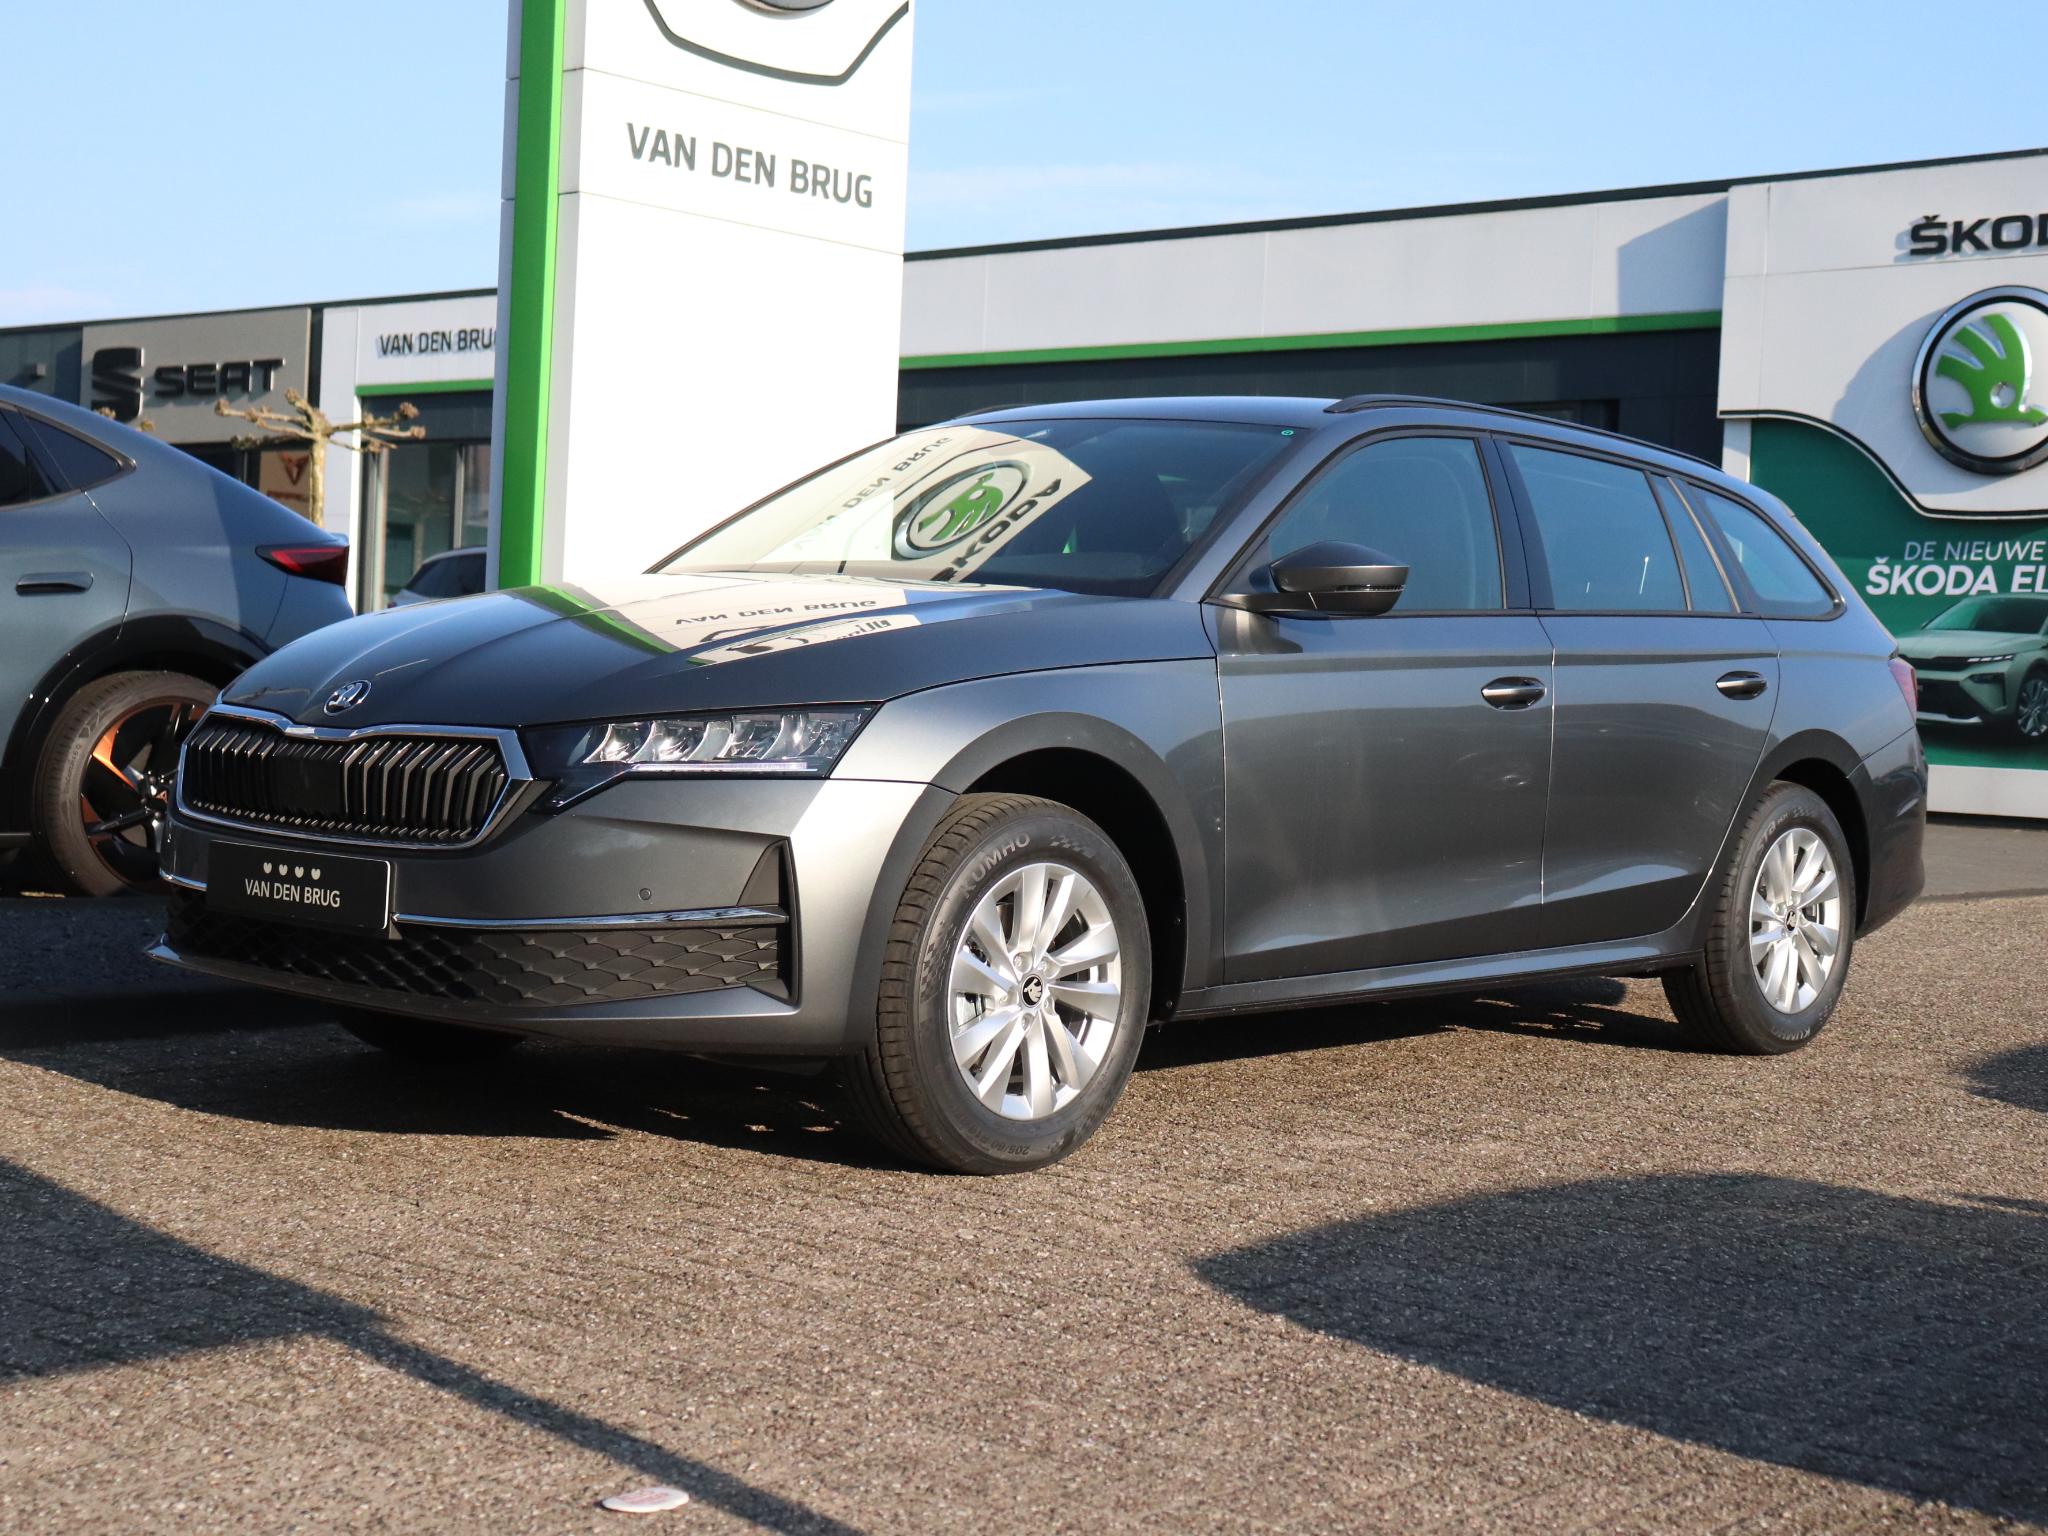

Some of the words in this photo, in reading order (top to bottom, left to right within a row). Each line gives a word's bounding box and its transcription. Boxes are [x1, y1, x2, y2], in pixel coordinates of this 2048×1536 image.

[627, 122, 696, 171] VAN
[712, 141, 776, 188] DEN
[790, 158, 872, 208] BRUG
[1910, 213, 2048, 256] ŠKO
[380, 333, 413, 356] VAN
[418, 330, 452, 353] DEN
[457, 327, 496, 351] BRU
[154, 358, 286, 398] SEAT
[1904, 541, 1937, 561] DE
[1944, 541, 2046, 562] NIEUWE
[1865, 556, 1999, 596] ŠKODA
[960, 833, 1031, 899] KUMHO
[245, 878, 270, 898] VAN
[273, 882, 300, 902] DEN
[303, 886, 341, 908] BRUG
